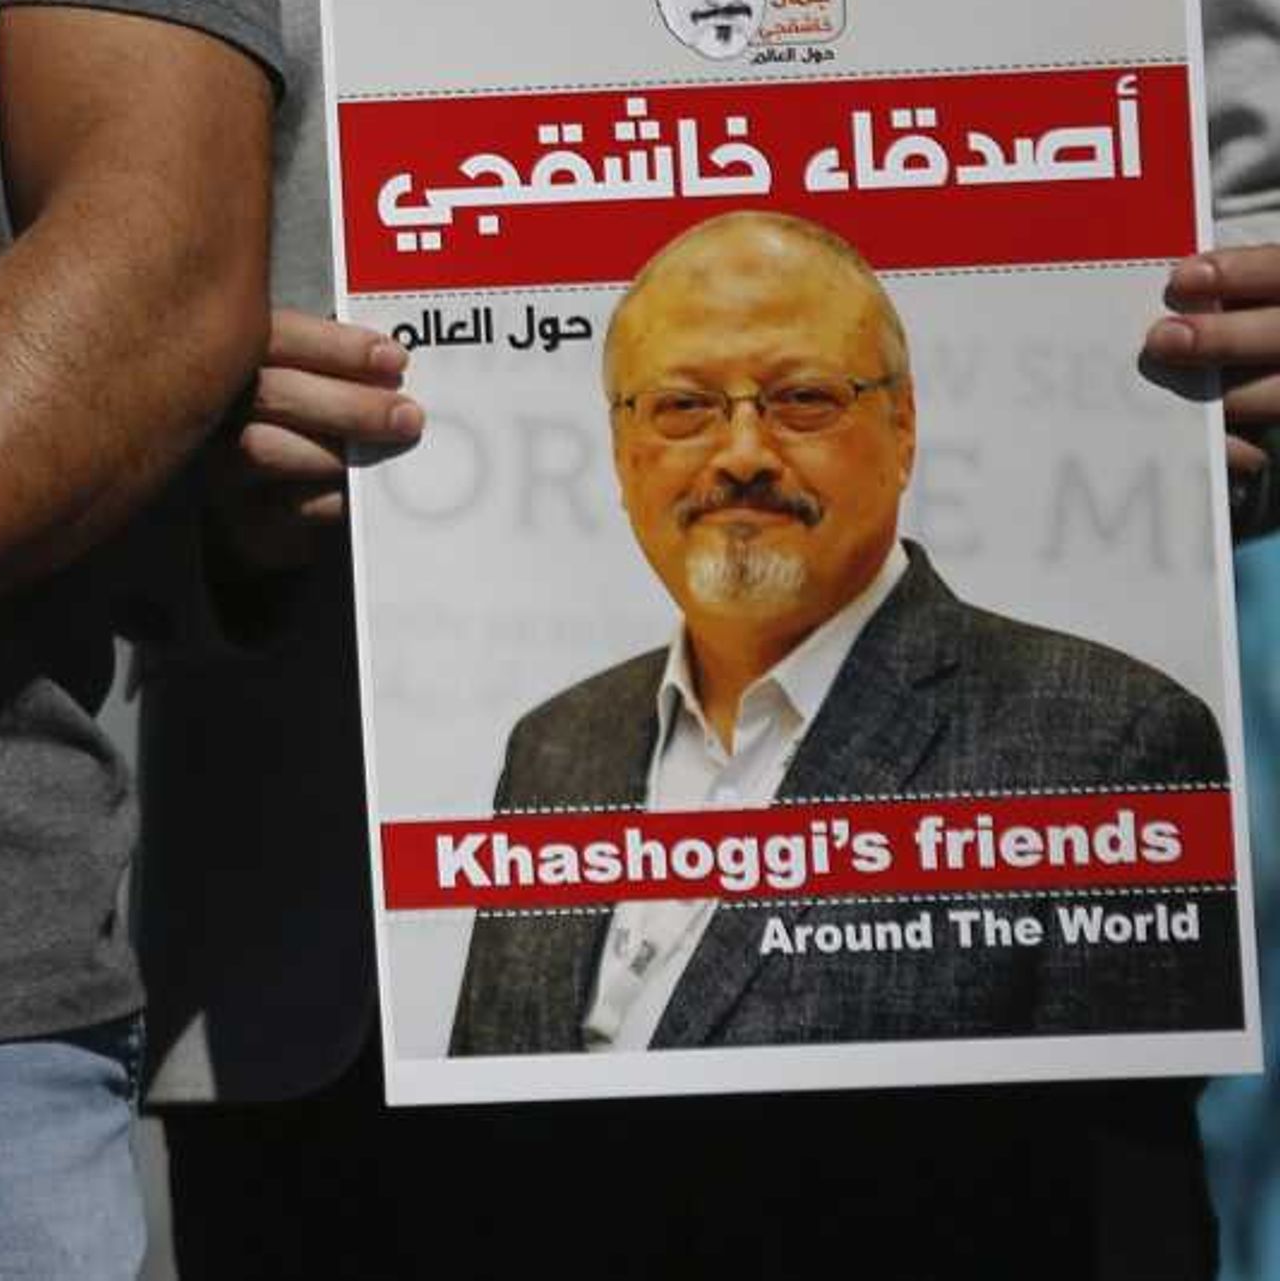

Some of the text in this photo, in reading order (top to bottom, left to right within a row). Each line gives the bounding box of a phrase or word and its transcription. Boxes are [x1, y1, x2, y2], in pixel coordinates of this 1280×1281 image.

[749, 46, 836, 64] حول العالم
[376, 74, 1142, 251] أصدقاء خاشقجي
[392, 305, 593, 352] حول العالم
[437, 810, 1181, 891] Khashoggi's friends
[759, 903, 1199, 955] Around The World
